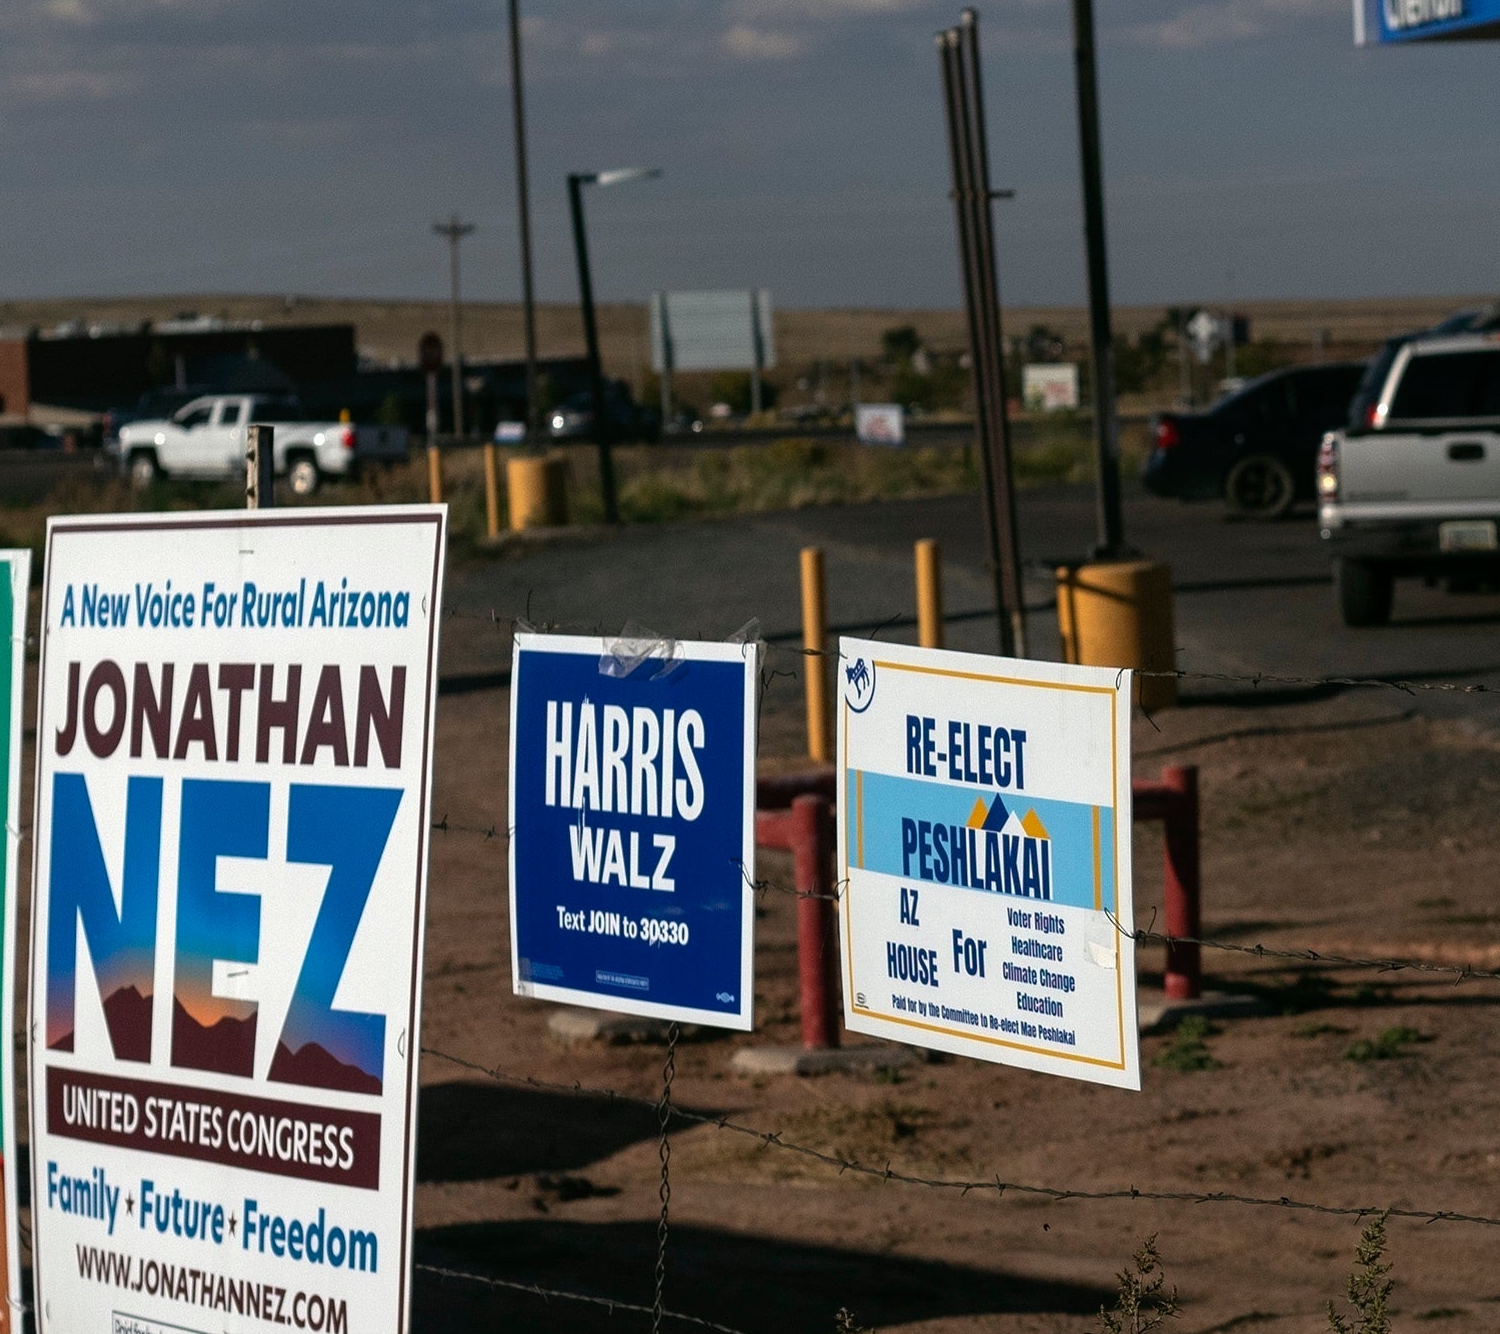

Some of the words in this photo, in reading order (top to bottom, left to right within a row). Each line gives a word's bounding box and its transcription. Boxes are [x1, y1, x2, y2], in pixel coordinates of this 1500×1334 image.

[60, 584, 75, 627] A
[81, 584, 131, 627] New
[135, 579, 195, 628] Voice
[201, 582, 238, 628] For
[241, 577, 306, 628] Rural
[309, 577, 410, 628] Arizona
[55, 659, 407, 769] JONATHAN
[544, 698, 706, 821] HARRIS
[905, 713, 1027, 790] RE-ELECT
[568, 823, 676, 893] WALZ
[900, 816, 1051, 901] PESHLAKAI
[556, 905, 586, 932] Text
[588, 910, 620, 937] JOIN
[623, 916, 637, 939] to
[640, 918, 689, 946] 30330
[900, 887, 919, 926] AZ
[1007, 907, 1032, 930] Voter
[1034, 910, 1065, 935] Rights
[46, 770, 404, 1097] NEZ
[952, 928, 987, 978] For
[1011, 935, 1063, 962] Healthcare
[886, 941, 939, 987] HOUSE
[1002, 961, 1037, 985] Climate
[1039, 965, 1075, 992] Change
[892, 994, 906, 1011] Paid
[907, 997, 917, 1013] for
[918, 1000, 927, 1017] by
[928, 1001, 940, 1018] the
[941, 1004, 979, 1027] Committee
[980, 1011, 988, 1028] to
[989, 1013, 1019, 1034] Re-elect
[1020, 1021, 1037, 1037] Mae
[1038, 1025, 1075, 1046] Peshlakai
[1017, 991, 1063, 1018] Education
[62, 1084, 139, 1134] UNITED
[144, 1096, 222, 1148] STATES
[227, 1110, 354, 1170] CONGRESS
[47, 1160, 120, 1236] Family
[139, 1179, 224, 1244] Future
[242, 1198, 378, 1273] Freedom
